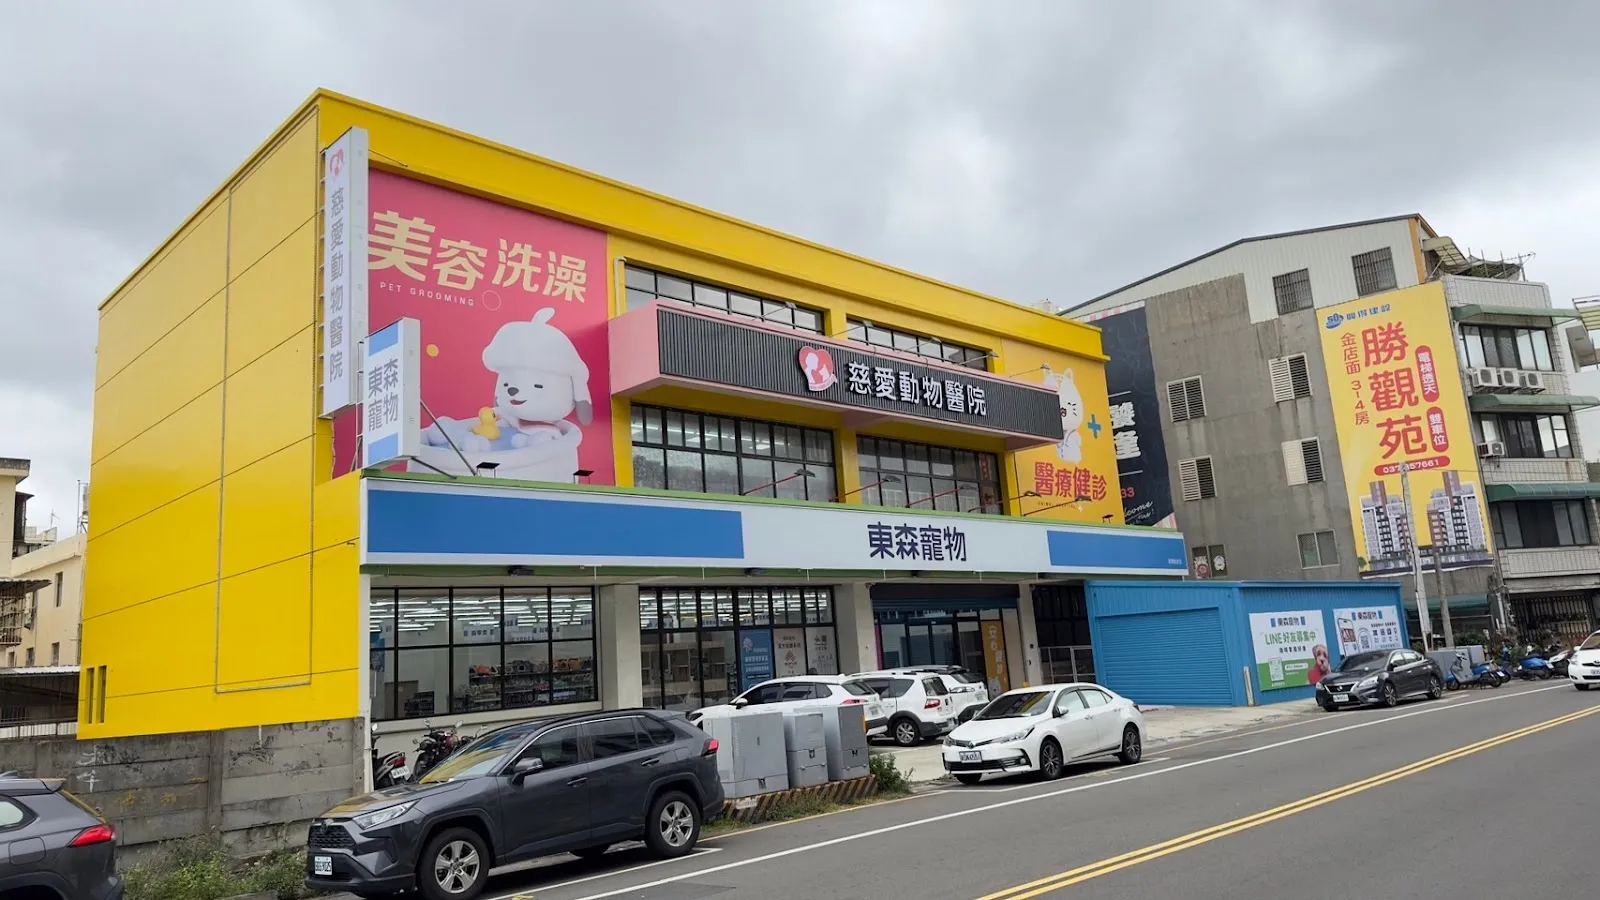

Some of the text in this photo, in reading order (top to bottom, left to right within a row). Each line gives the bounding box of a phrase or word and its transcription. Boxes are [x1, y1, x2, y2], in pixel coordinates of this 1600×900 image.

[368, 210, 587, 304] 美容洗澡
[329, 187, 344, 382] 慈愛動物醫院
[380, 281, 475, 307] PET GROOMING
[1340, 332, 1361, 375] 金店面
[1417, 351, 1437, 395] 電梯透天
[848, 361, 987, 416] 慈愛動物醫院
[1361, 320, 1428, 460] 勝觀苑
[1429, 413, 1447, 446] 雙車位
[1034, 461, 1108, 501] 醫療健診
[867, 521, 967, 562] 東森寵物
